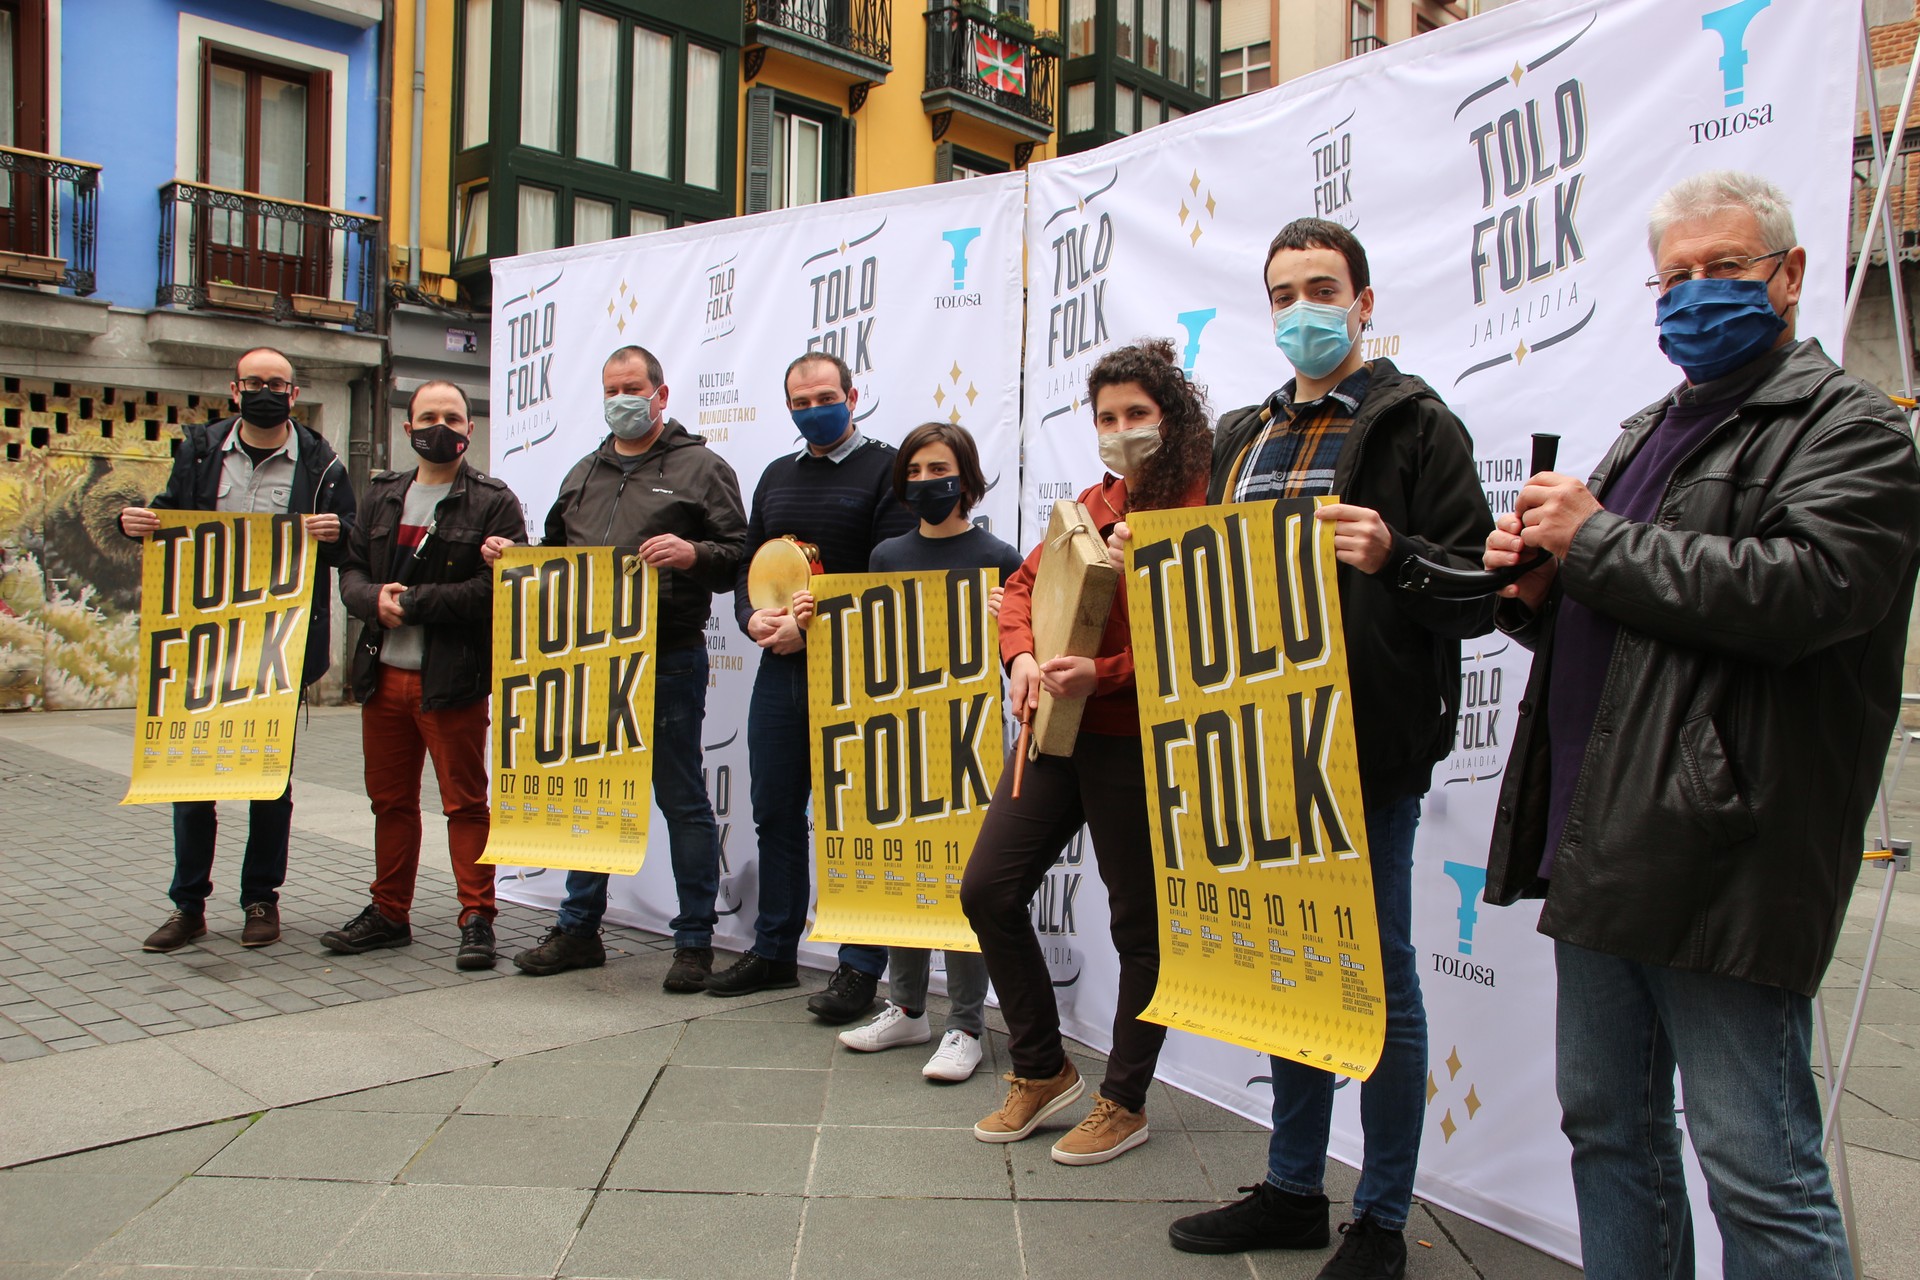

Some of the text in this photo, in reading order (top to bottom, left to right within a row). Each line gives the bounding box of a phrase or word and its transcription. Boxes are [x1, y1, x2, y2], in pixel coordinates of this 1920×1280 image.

[1312, 132, 1351, 182] TOLO
[1469, 78, 1589, 209] TOLO
[1052, 212, 1115, 298] TOLO
[1471, 172, 1586, 306] FOLK
[709, 267, 735, 298] TOLO
[810, 256, 878, 330] TOLO
[706, 292, 733, 324] FOLK
[1048, 278, 1110, 369] FOLK
[507, 301, 556, 364] TOLO
[506, 353, 554, 417] FOLK
[699, 372, 734, 389] KULTURA
[699, 389, 739, 407] HERRIKOIA
[698, 407, 756, 425] MUNDUETAKO
[1476, 458, 1523, 482] LTURA
[1039, 482, 1073, 499] KULTURA
[152, 514, 308, 619] TOLO
[501, 546, 648, 664] TOLO
[1133, 497, 1332, 703] TOLO
[816, 568, 988, 711] TOLO
[148, 606, 305, 717] FOLK
[501, 651, 649, 769] FOLK
[146, 721, 163, 740] 07
[170, 721, 187, 740] 08
[193, 720, 210, 739] 09
[219, 720, 234, 738] 10
[243, 720, 256, 738] 11
[267, 719, 279, 737] 11
[821, 692, 994, 832] FOLK
[501, 774, 516, 793] 07
[524, 775, 539, 795] 08
[548, 776, 563, 796] 09
[573, 777, 587, 797] 10
[598, 778, 610, 798] 11
[623, 780, 635, 800] 11
[1151, 684, 1360, 873] FOLK
[826, 837, 844, 859] 07
[854, 837, 873, 860] 08
[883, 838, 902, 861] 09
[915, 839, 931, 862] 10
[945, 841, 959, 864] 11
[1032, 874, 1083, 936] OLK
[1167, 876, 1186, 908] 07
[1197, 881, 1218, 914] 08
[1228, 886, 1251, 921] 09
[1264, 893, 1285, 927] 10
[1299, 899, 1318, 933] 11
[1334, 905, 1354, 940] 11
